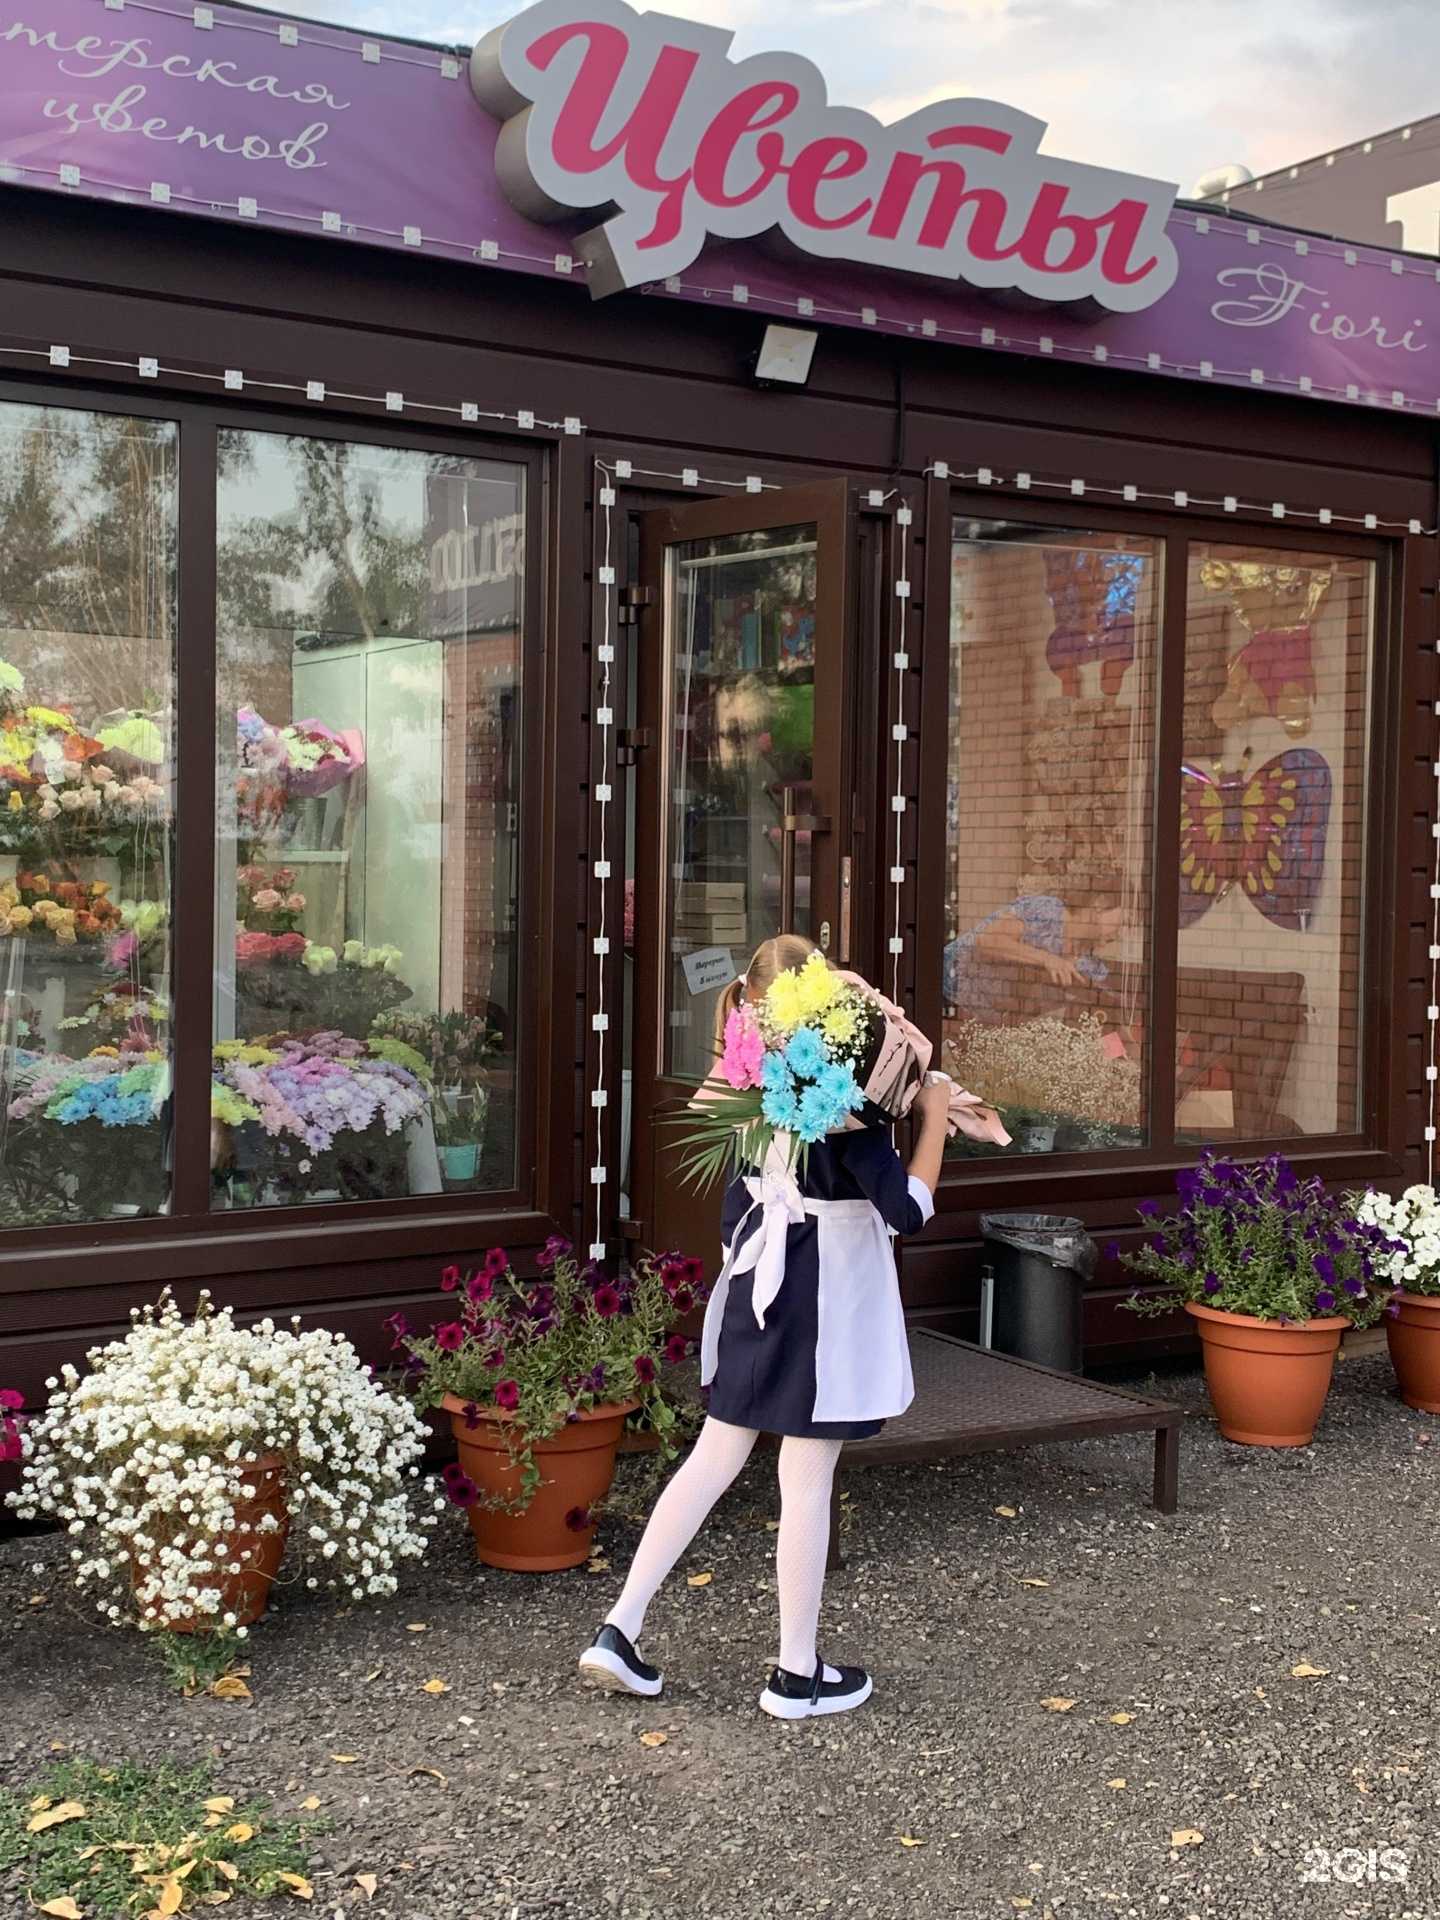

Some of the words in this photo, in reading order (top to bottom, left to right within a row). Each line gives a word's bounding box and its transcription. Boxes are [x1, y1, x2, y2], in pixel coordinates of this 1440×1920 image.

[0, 22, 351, 109] терская
[43, 84, 327, 169] цветов
[527, 23, 1156, 284] Цветы
[1210, 262, 1428, 352] Fiori
